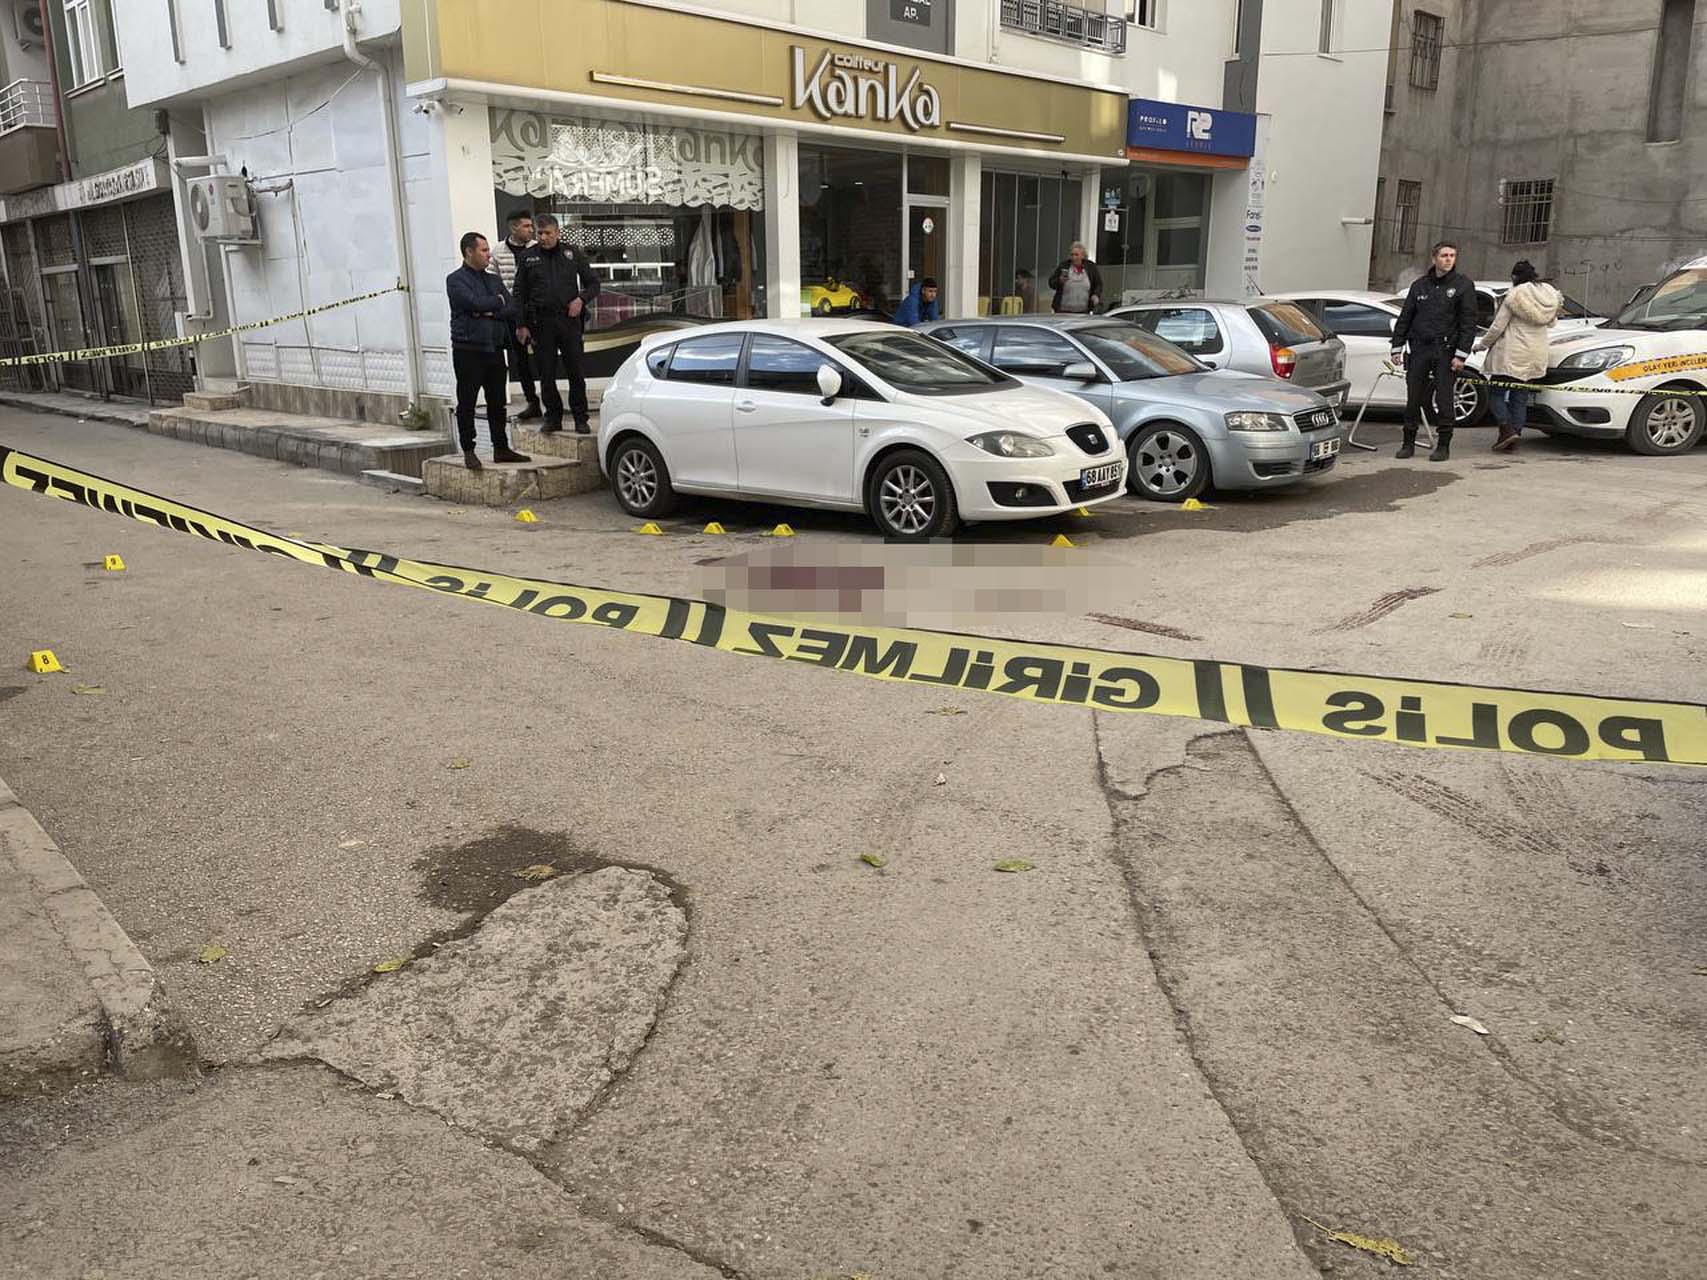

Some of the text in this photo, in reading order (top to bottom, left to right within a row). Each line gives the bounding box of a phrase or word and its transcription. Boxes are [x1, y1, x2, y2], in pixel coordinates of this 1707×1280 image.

[833, 53, 886, 74] coiffeur
[1087, 470, 1097, 485] 68
[41, 654, 50, 665] 8
